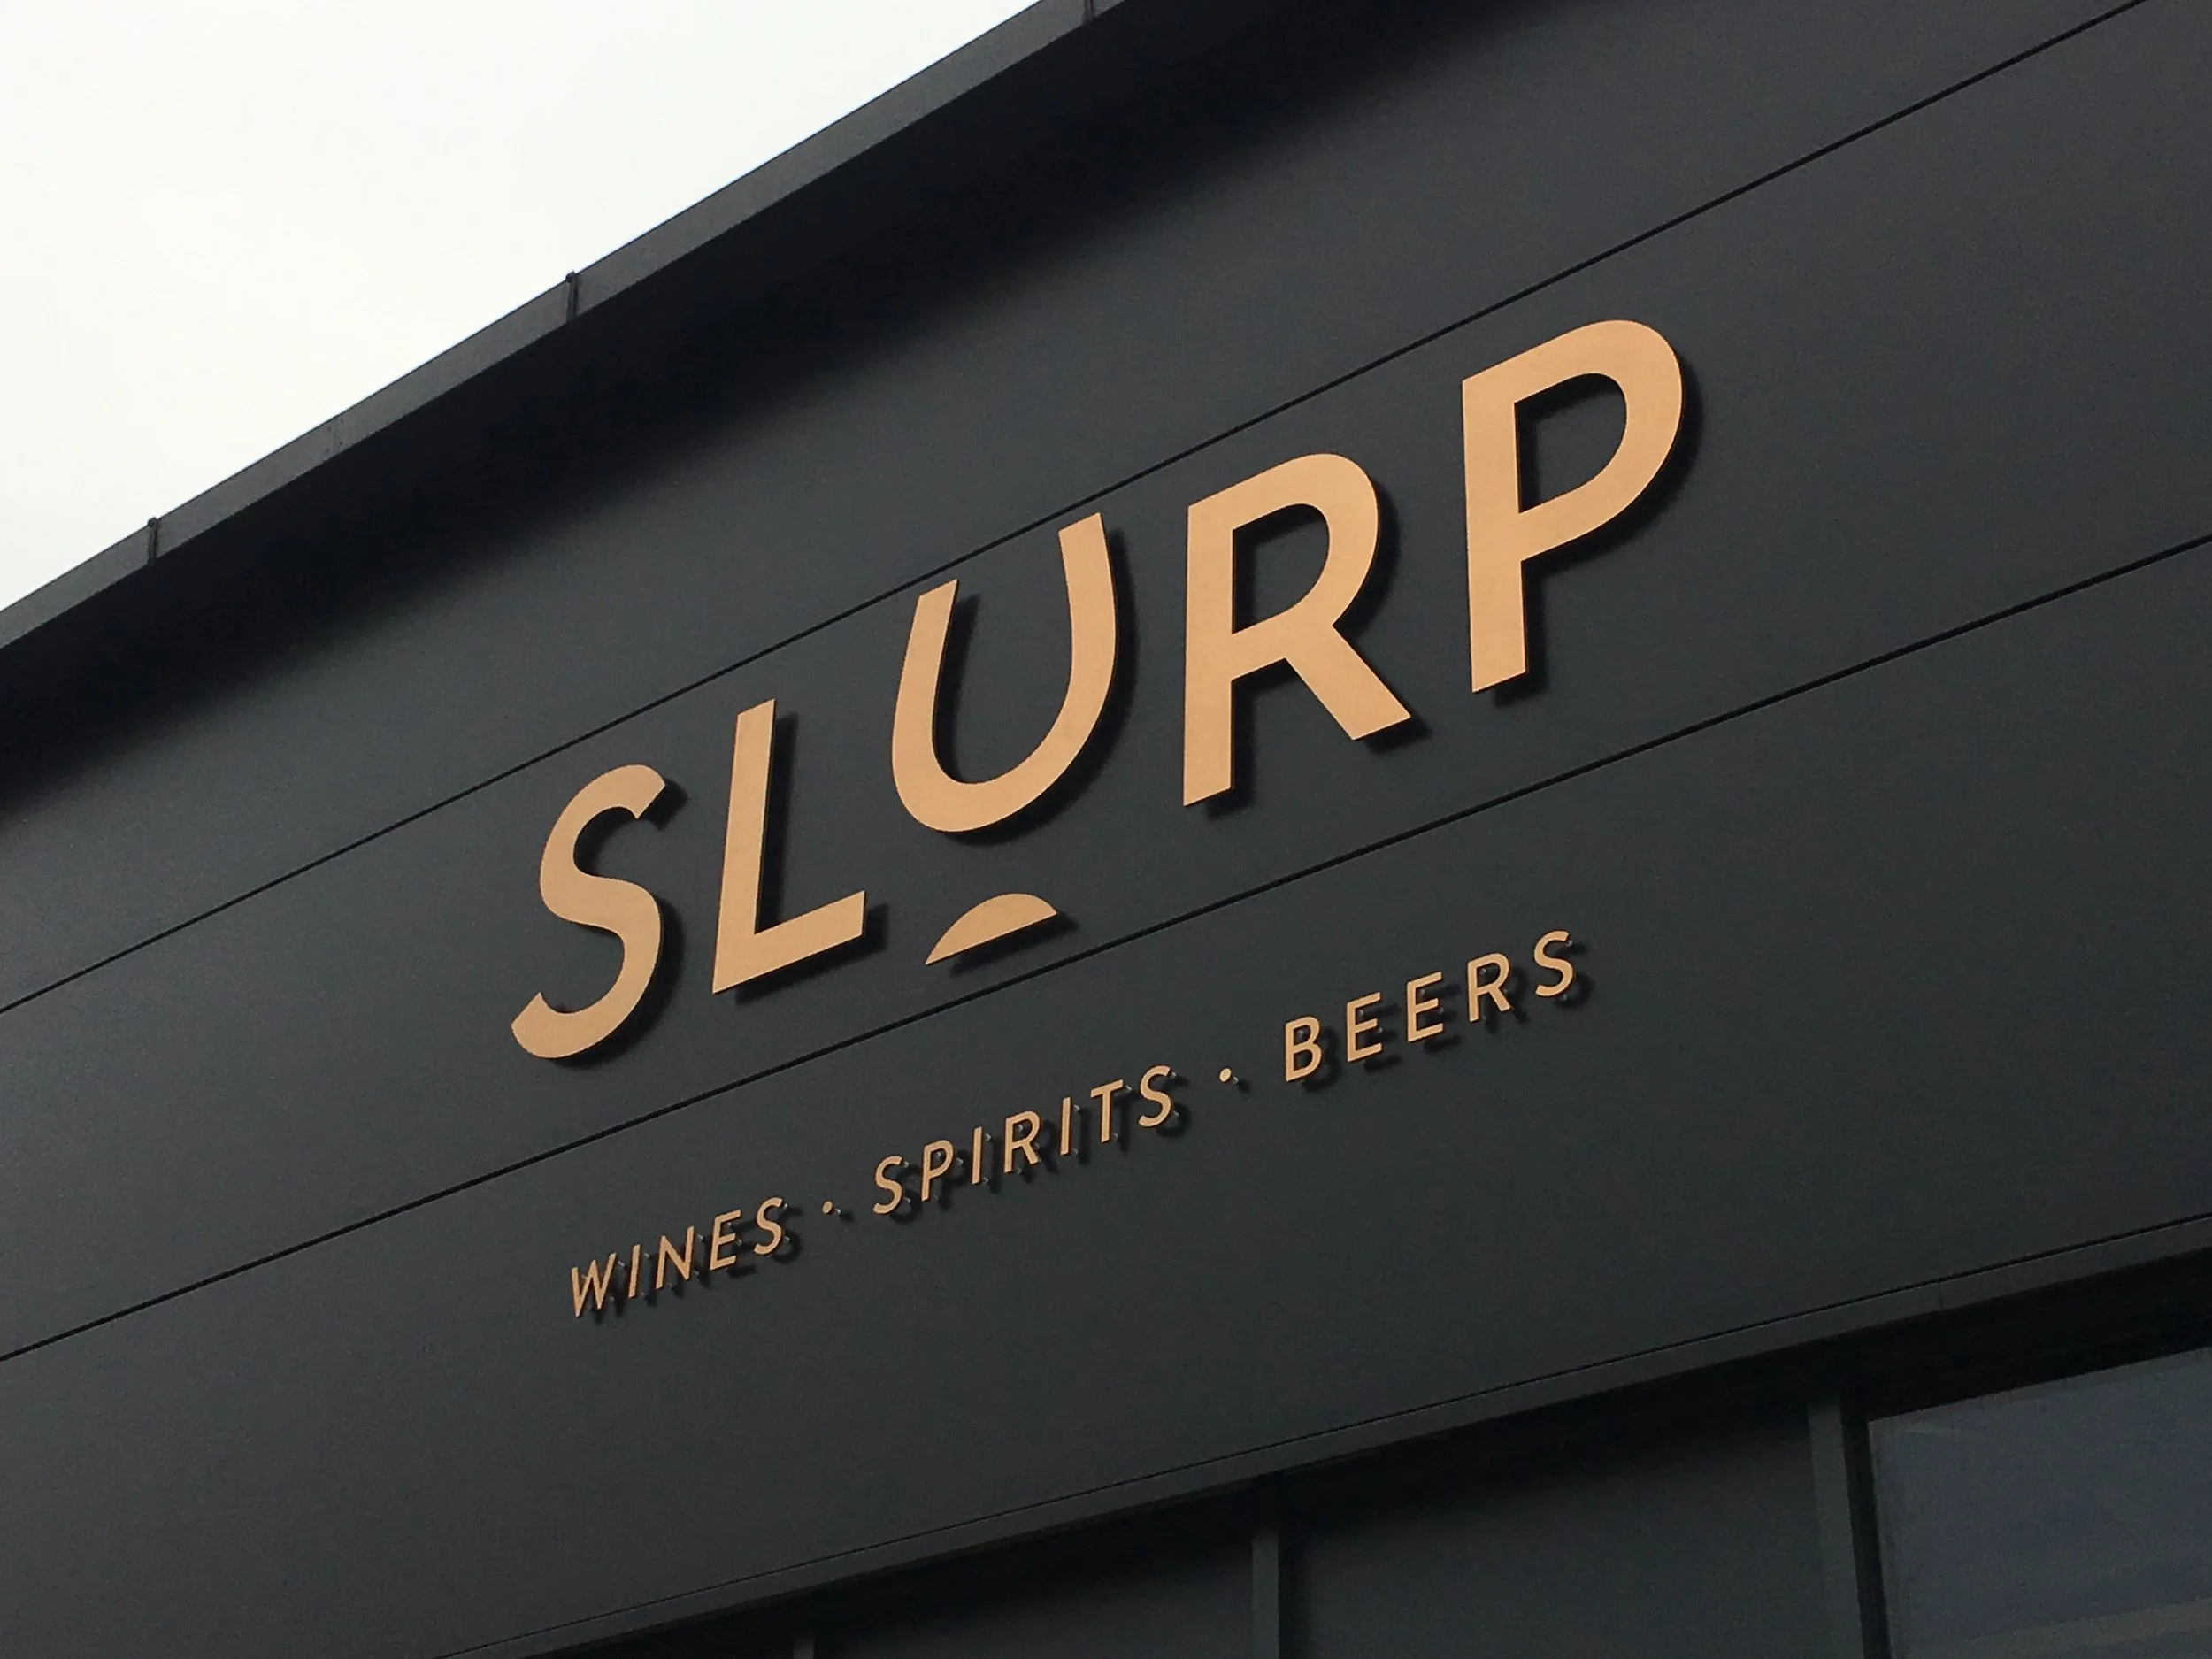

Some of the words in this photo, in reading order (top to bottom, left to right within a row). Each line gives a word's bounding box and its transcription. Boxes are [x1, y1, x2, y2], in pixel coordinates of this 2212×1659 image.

[511, 319, 1685, 1060] SLURP
[571, 1197, 785, 1318] WINES
[872, 1064, 1174, 1215] SPIRITS
[1284, 929, 1576, 1082] BEERS
